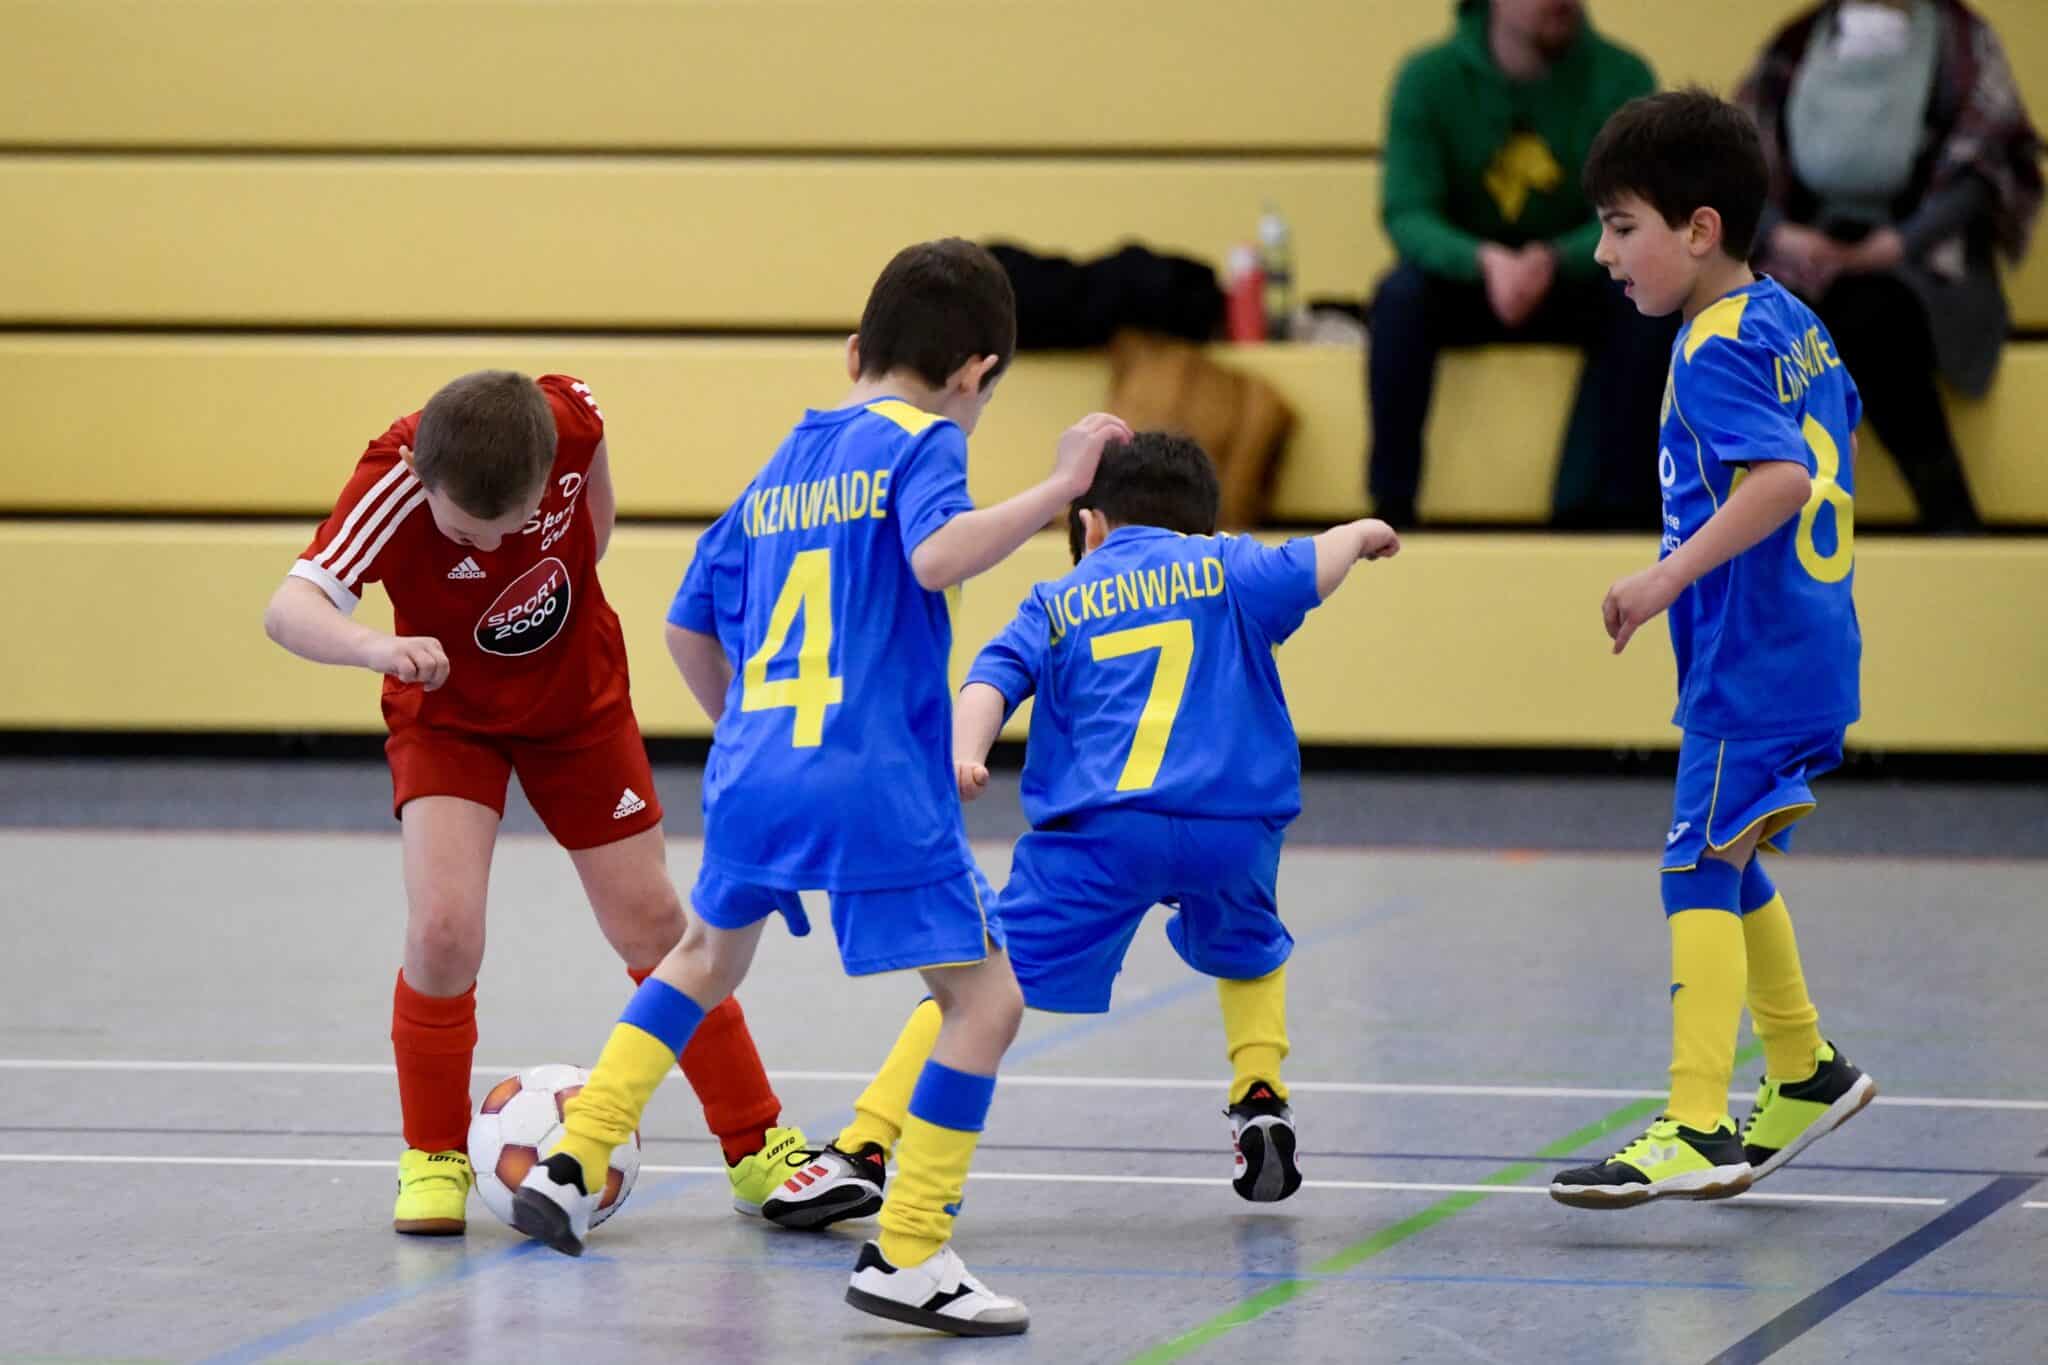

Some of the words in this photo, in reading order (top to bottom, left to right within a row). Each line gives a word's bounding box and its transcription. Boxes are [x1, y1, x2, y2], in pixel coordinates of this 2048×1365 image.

[1795, 411, 1855, 584] 8
[487, 569, 559, 628] SPORT
[494, 596, 557, 641] 2000
[1045, 556, 1225, 645] UCKENWALD
[741, 547, 843, 749] 4
[1089, 618, 1195, 793] 7
[612, 799, 647, 820] adidas
